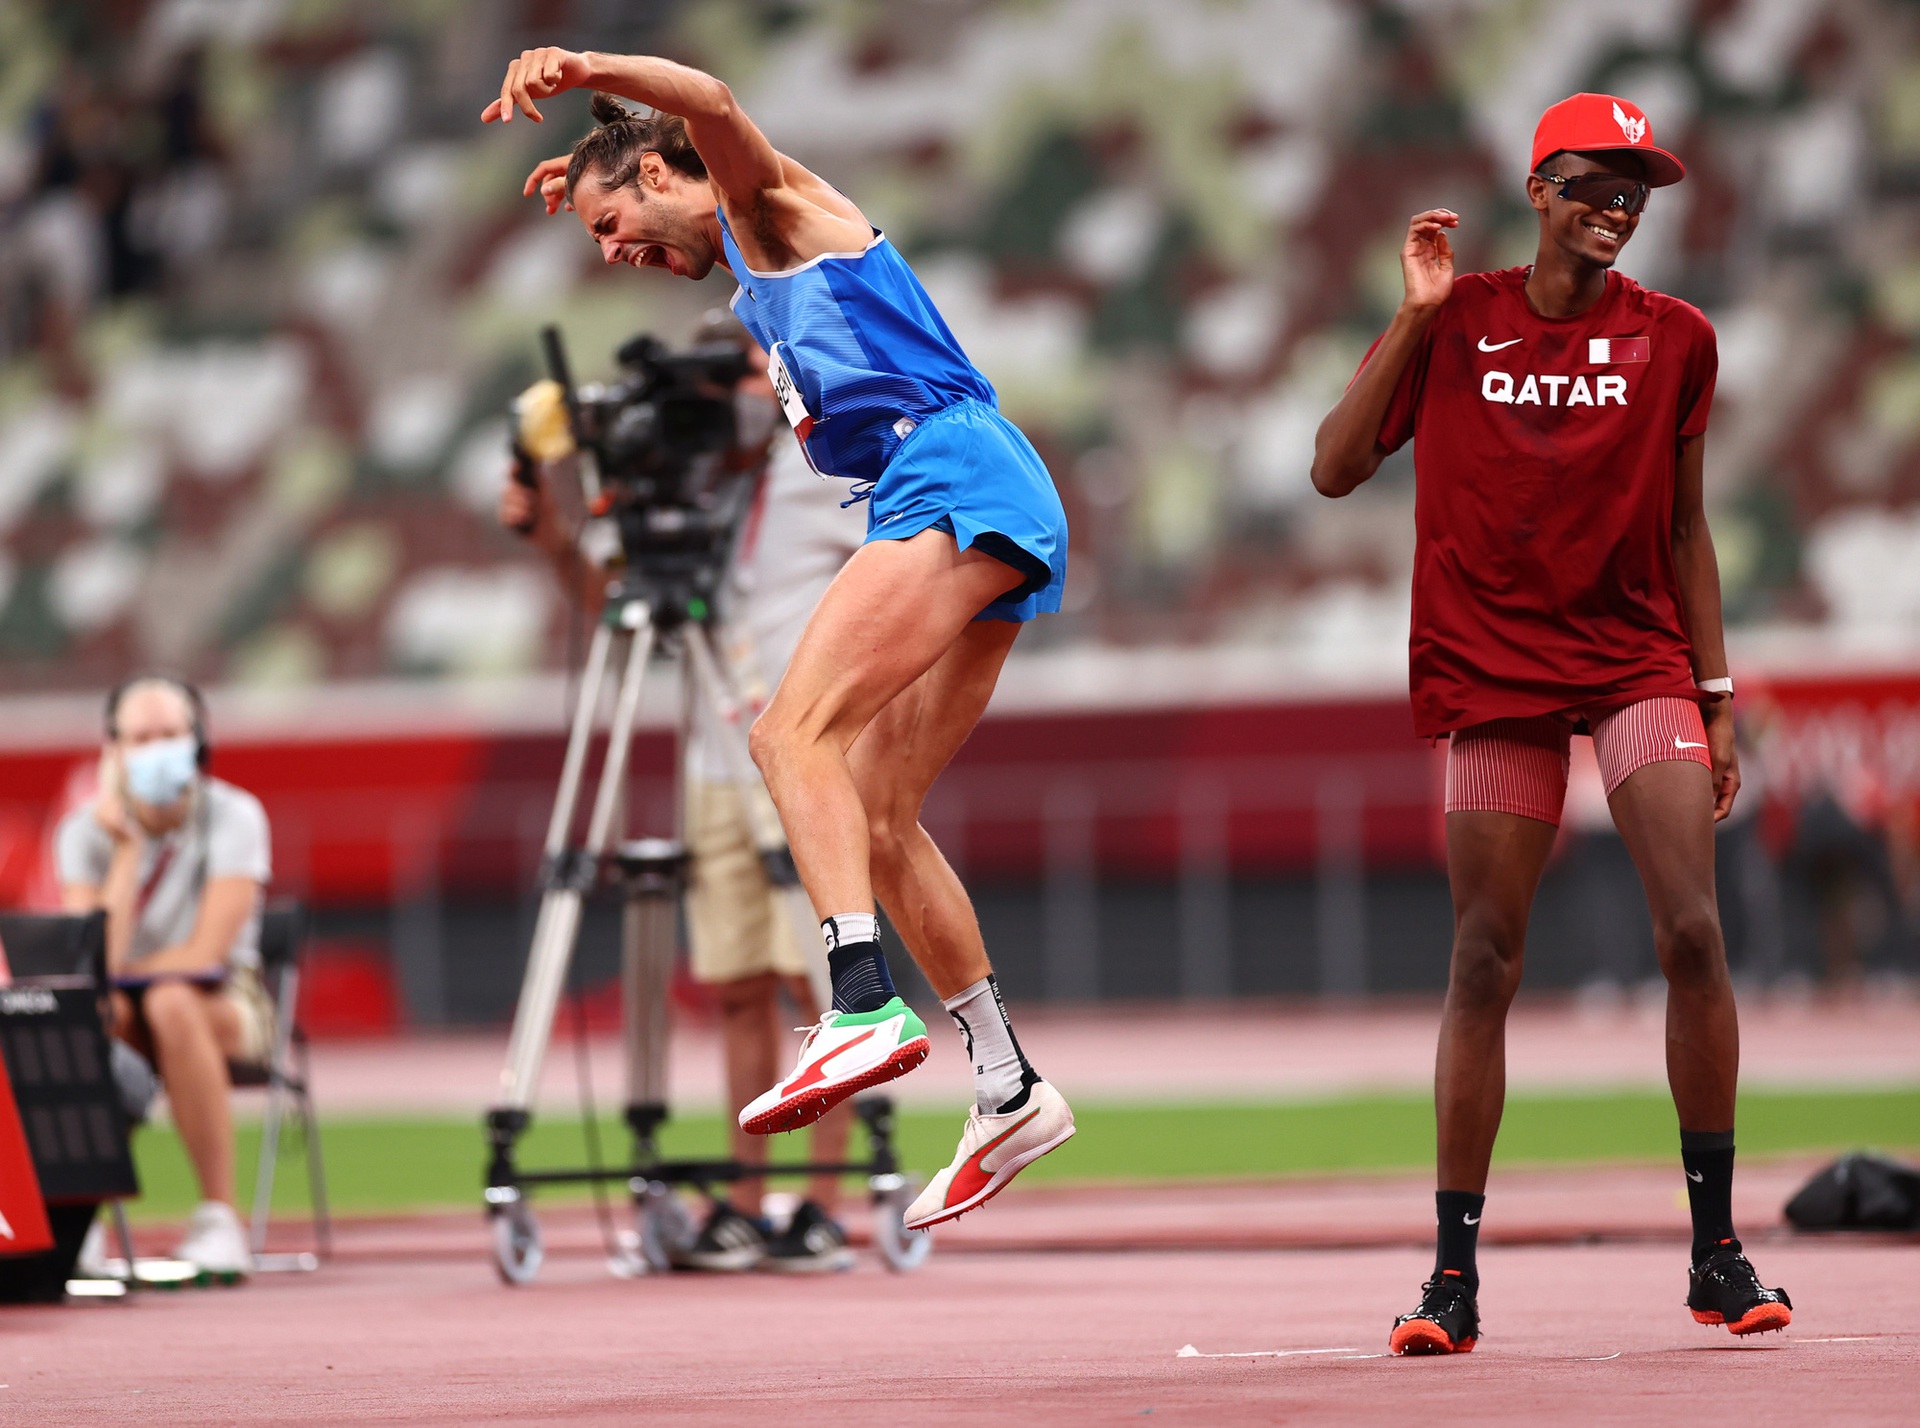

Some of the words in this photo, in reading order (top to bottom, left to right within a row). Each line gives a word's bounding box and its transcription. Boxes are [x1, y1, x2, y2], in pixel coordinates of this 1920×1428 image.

[1481, 370, 1628, 407] QATAR
[992, 981, 1002, 1000] HALF
[998, 1001, 1011, 1027] SHAVE
